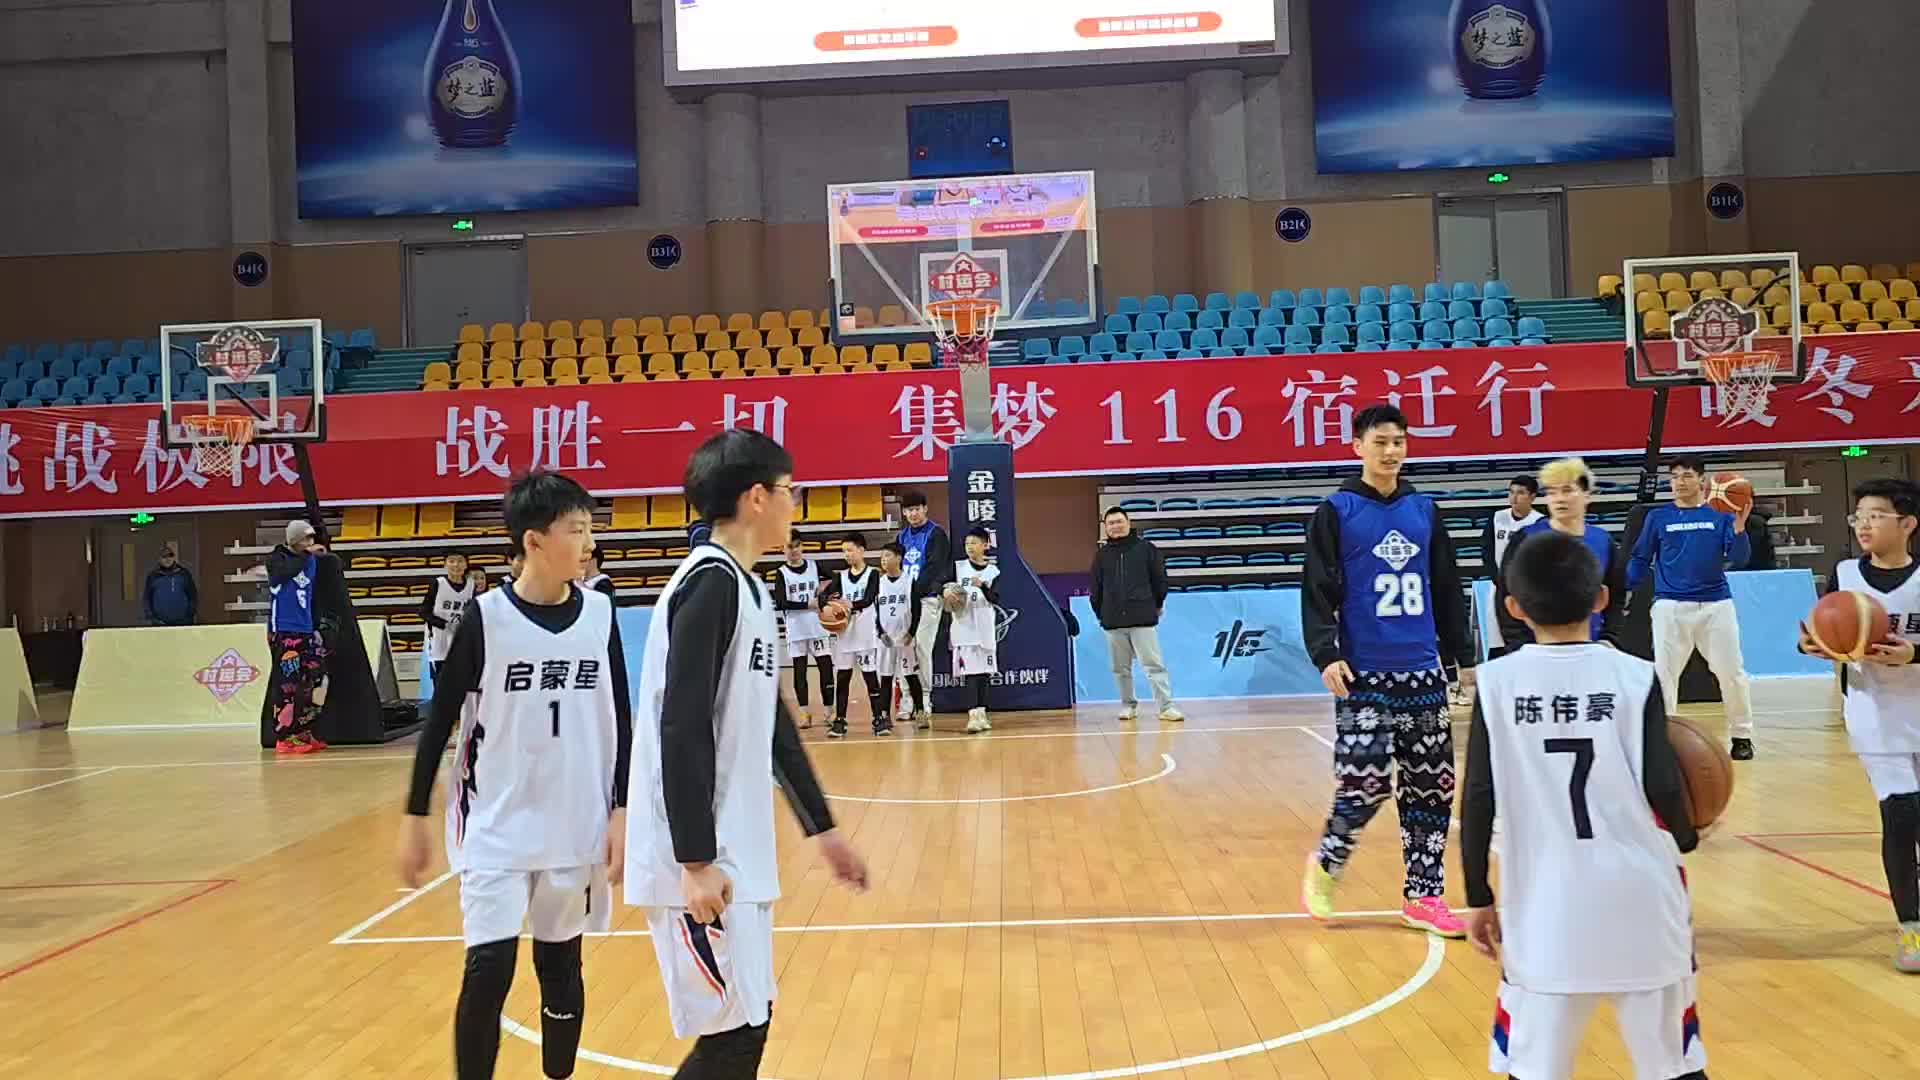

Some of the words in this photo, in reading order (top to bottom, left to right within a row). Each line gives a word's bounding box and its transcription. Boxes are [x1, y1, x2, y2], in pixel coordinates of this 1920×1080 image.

[1471, 26, 1525, 54] 梦之蓝
[447, 77, 497, 104] 梦之蓝
[1375, 573, 1424, 616] 28
[890, 607, 896, 617] 2
[504, 660, 600, 693] 启蒙星
[902, 658, 909, 668] 2
[549, 701, 560, 737] 1
[1515, 692, 1617, 725] 陈伟豪
[1544, 738, 1595, 839] 7
